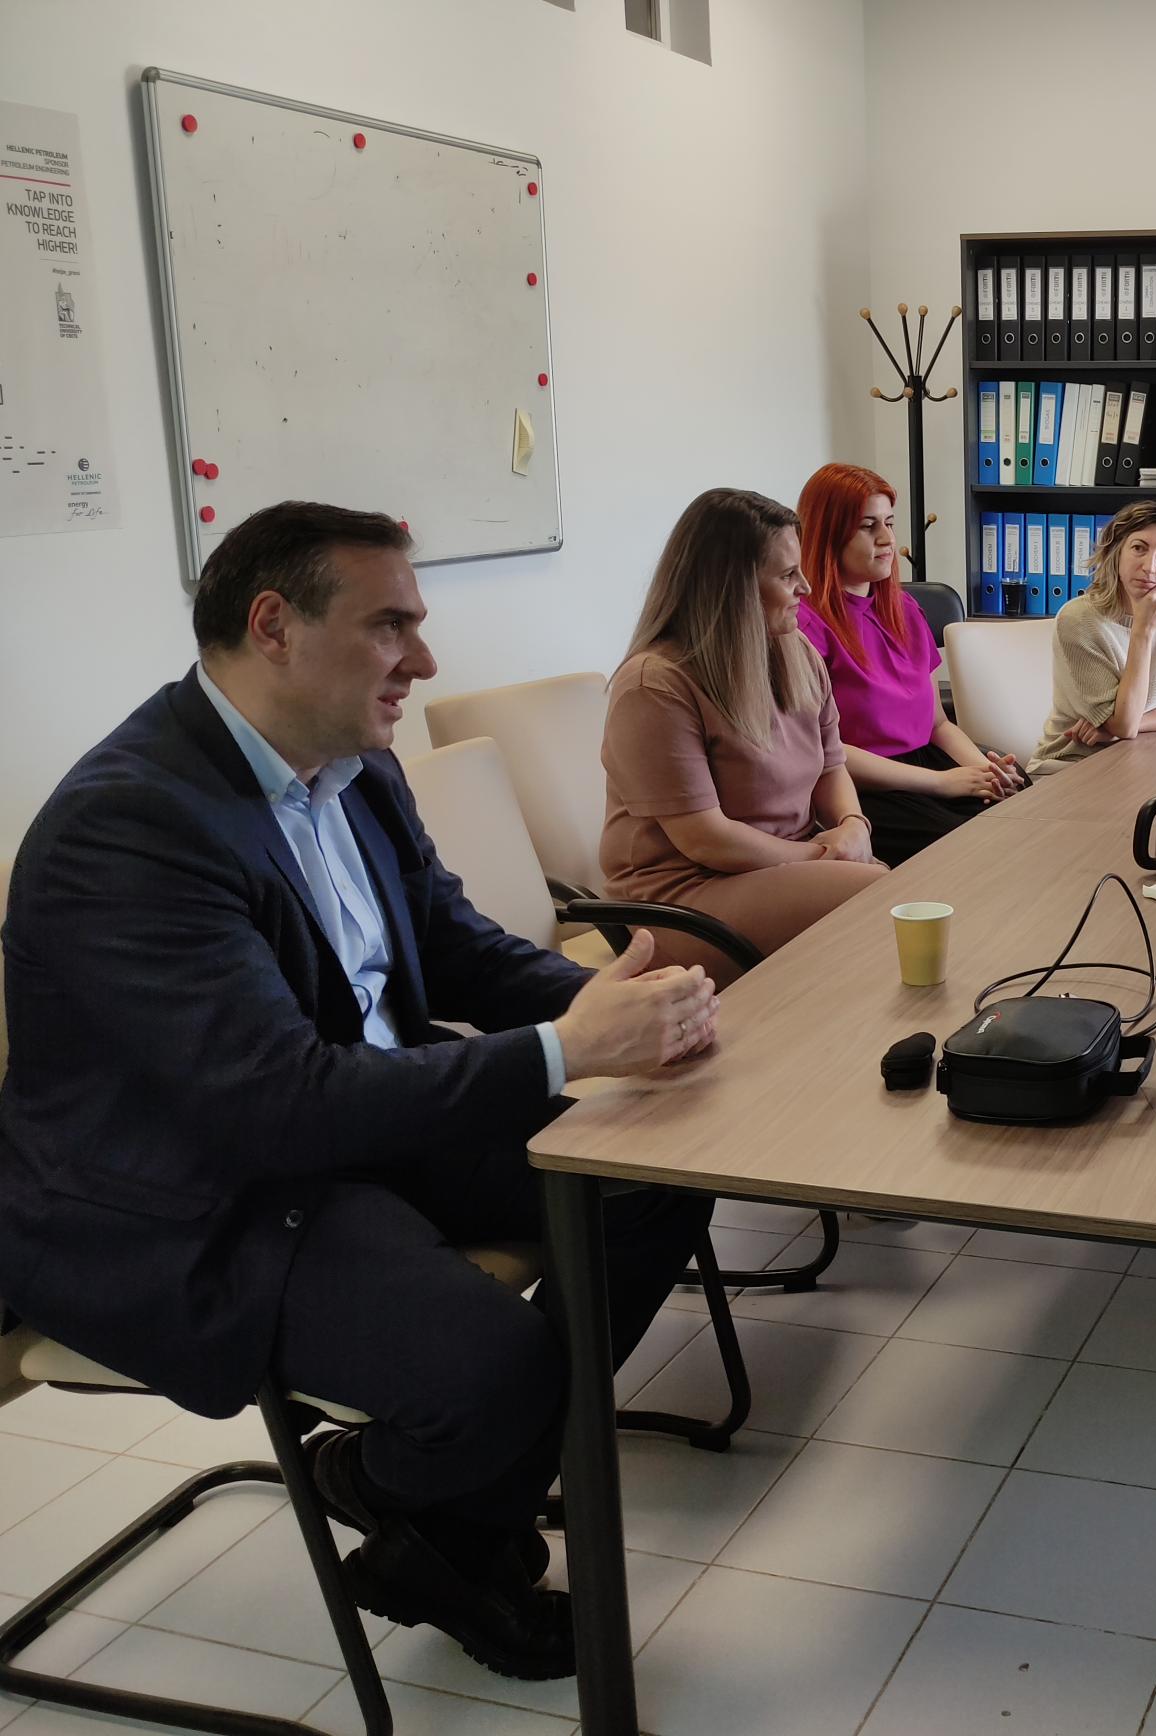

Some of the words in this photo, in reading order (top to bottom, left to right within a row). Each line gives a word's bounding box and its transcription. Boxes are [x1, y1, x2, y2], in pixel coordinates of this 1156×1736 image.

[6, 144, 35, 155] HELLENIC
[35, 149, 68, 160] PETROLEUM
[0, 160, 35, 170] PETROLEUM
[35, 165, 70, 176] ENGINEERING
[44, 158, 69, 168] SPONSOR
[25, 188, 47, 203] TAP
[48, 192, 73, 207] INTO
[6, 202, 76, 223] KNOWLEDGE
[25, 220, 40, 235] TO
[42, 223, 77, 239] REACH
[37, 238, 78, 255] HIGHER!
[67, 473, 102, 481] HELLENIC
[67, 501, 89, 509] energy
